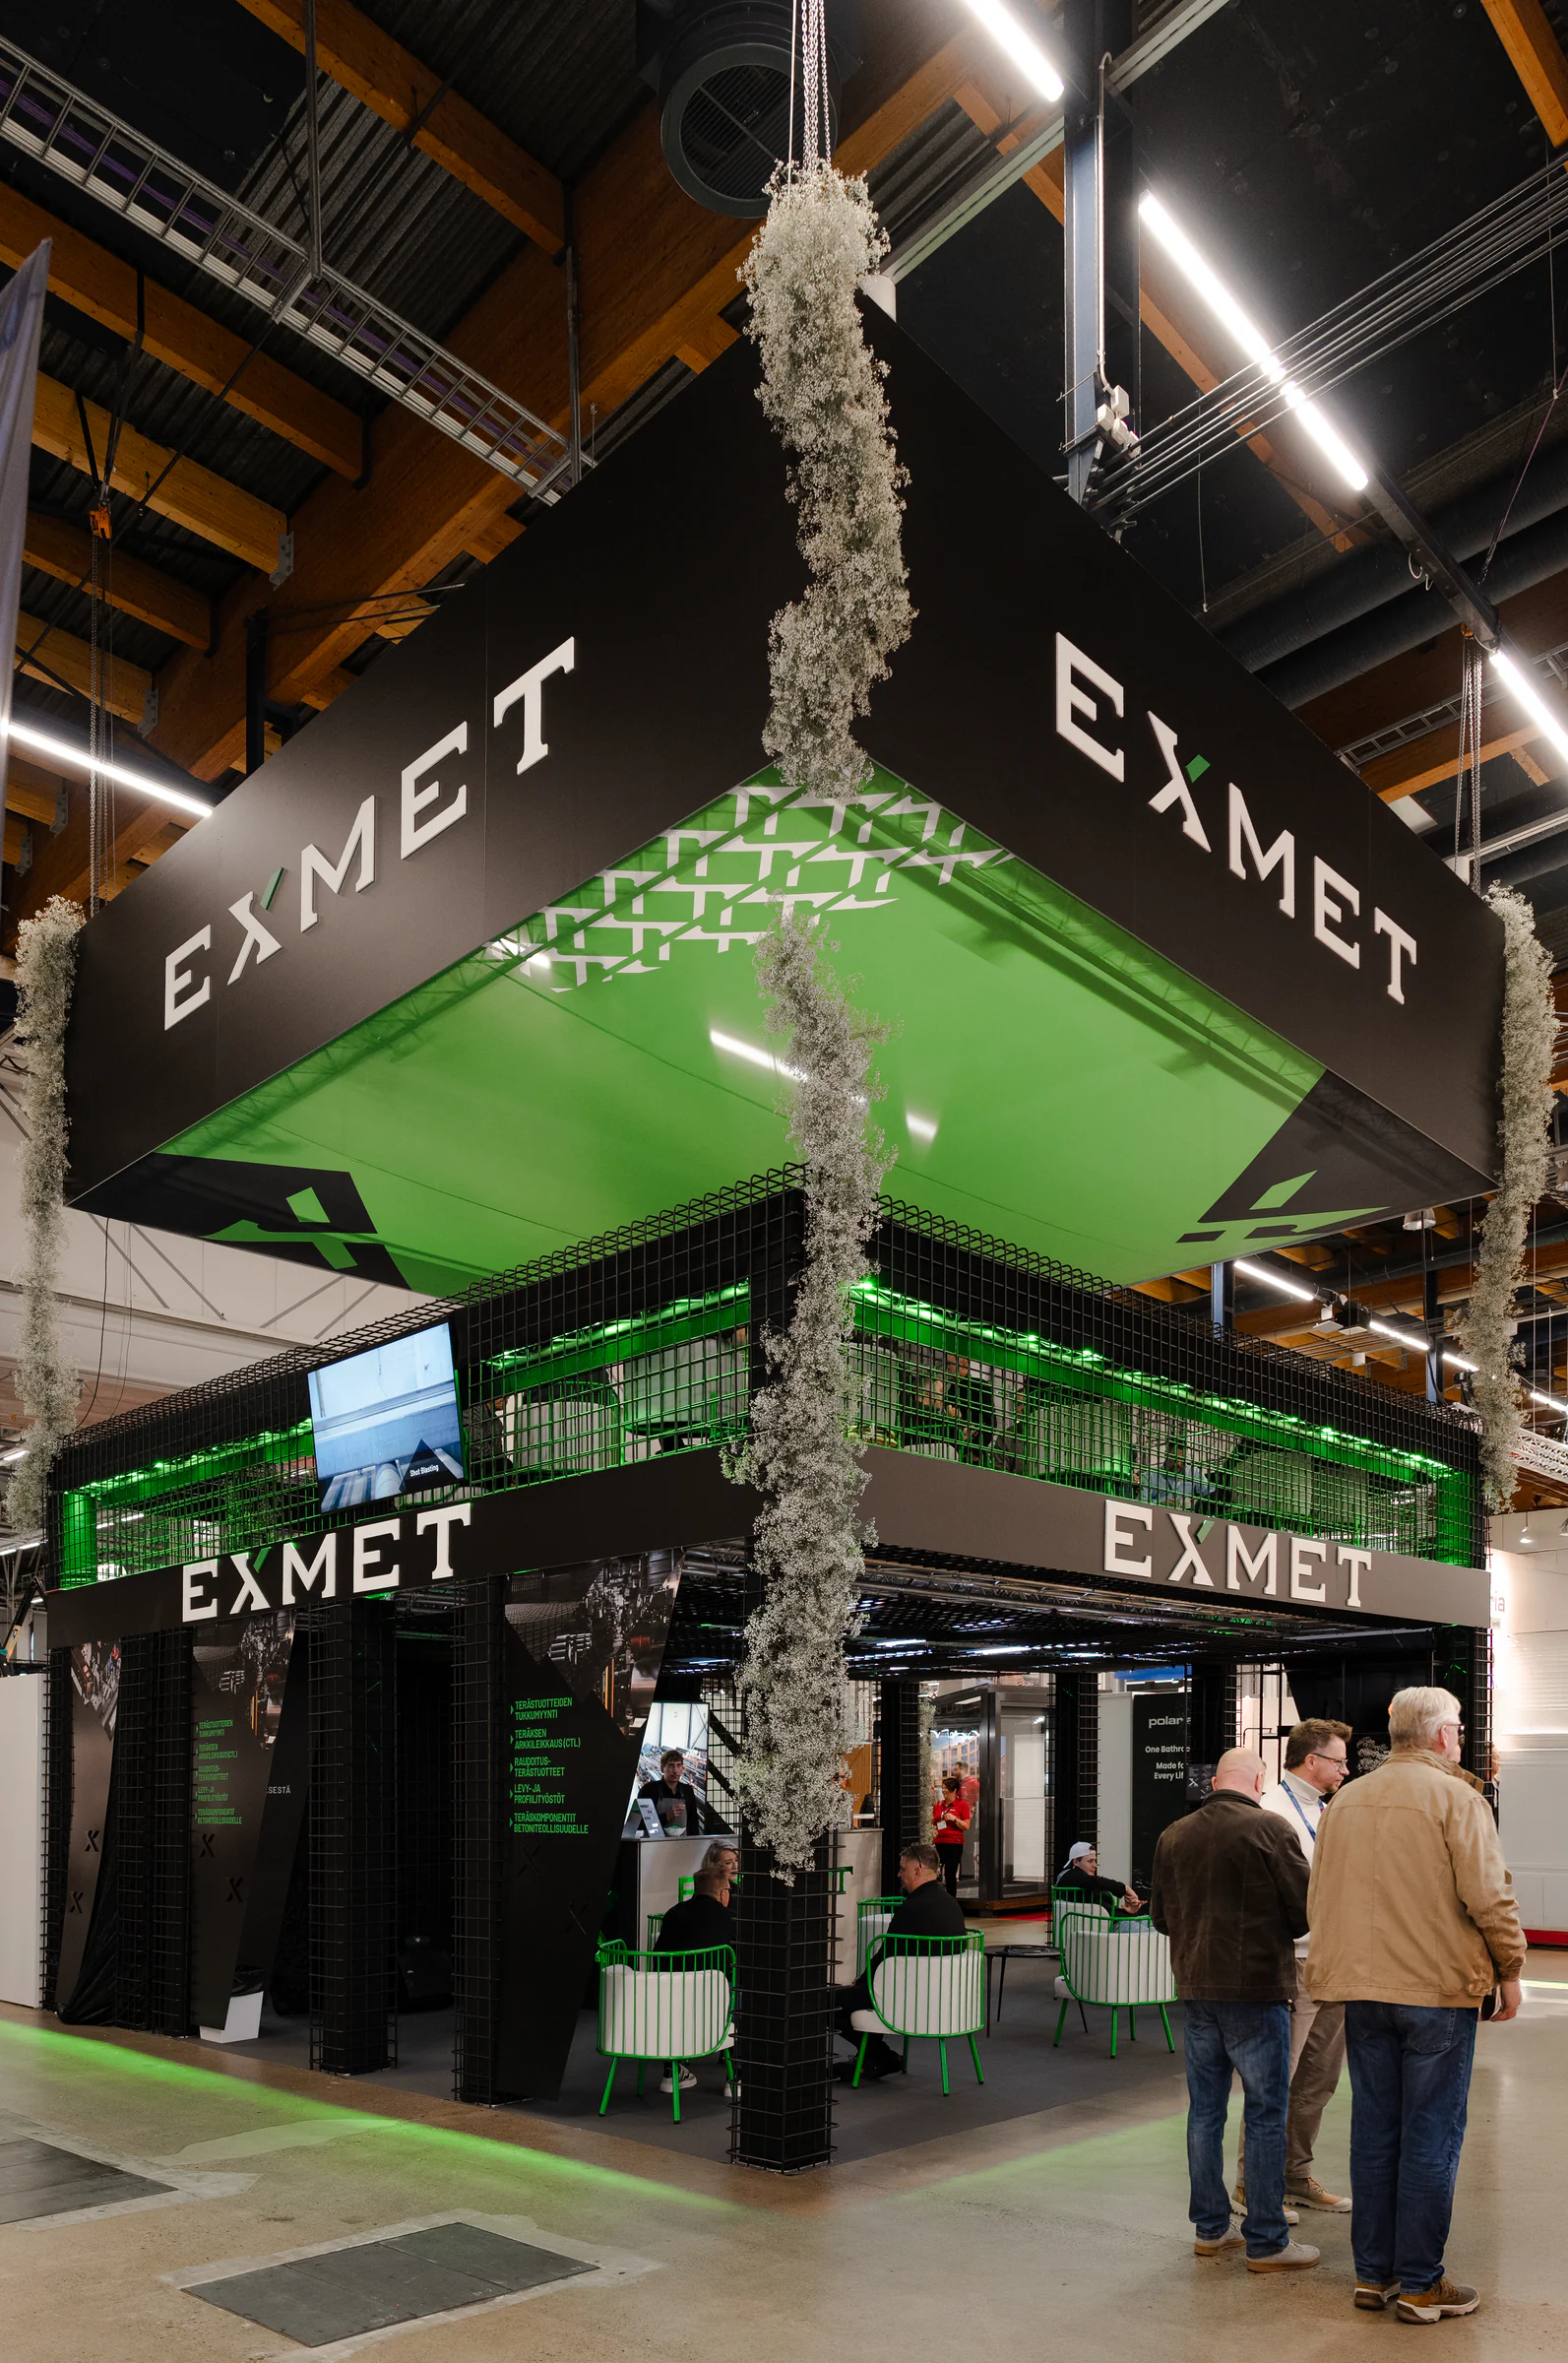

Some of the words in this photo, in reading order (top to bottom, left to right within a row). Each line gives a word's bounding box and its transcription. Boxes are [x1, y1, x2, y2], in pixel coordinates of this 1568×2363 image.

[1055, 632, 1417, 1004] EXMET
[164, 637, 575, 1030] EXMET
[409, 1468, 421, 1477] Shot
[420, 1464, 439, 1475] Blasting
[1103, 1500, 1372, 1607] EXMET
[182, 1502, 471, 1623] EXMET
[515, 1697, 573, 1710] TERÄSTUOTTEIDEN
[515, 1727, 547, 1740] TERÄKSEN
[563, 1737, 581, 1749] (CTL)
[1154, 1771, 1174, 1781] Every
[266, 1784, 291, 1795] SESTÄ
[514, 1784, 532, 1793] LEVY-
[533, 1784, 541, 1793] JA
